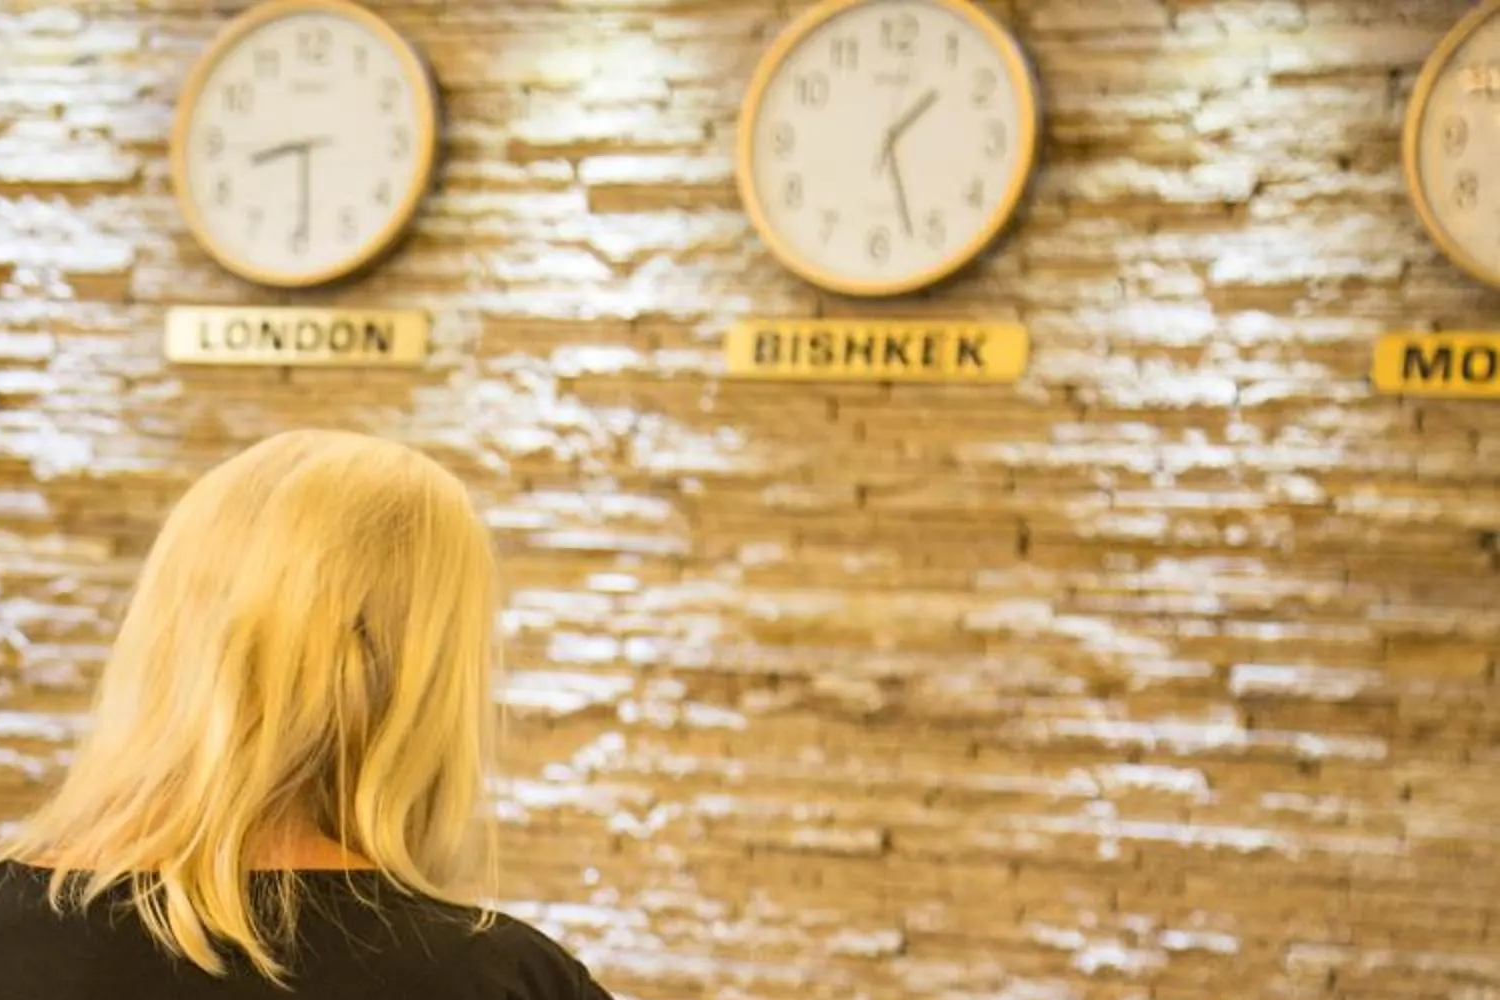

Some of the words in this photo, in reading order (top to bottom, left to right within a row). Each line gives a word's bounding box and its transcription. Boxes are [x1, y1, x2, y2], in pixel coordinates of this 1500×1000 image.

[200, 319, 395, 355] LONDON
[754, 330, 988, 366] BISHKEK
[1402, 345, 1498, 384] MO
